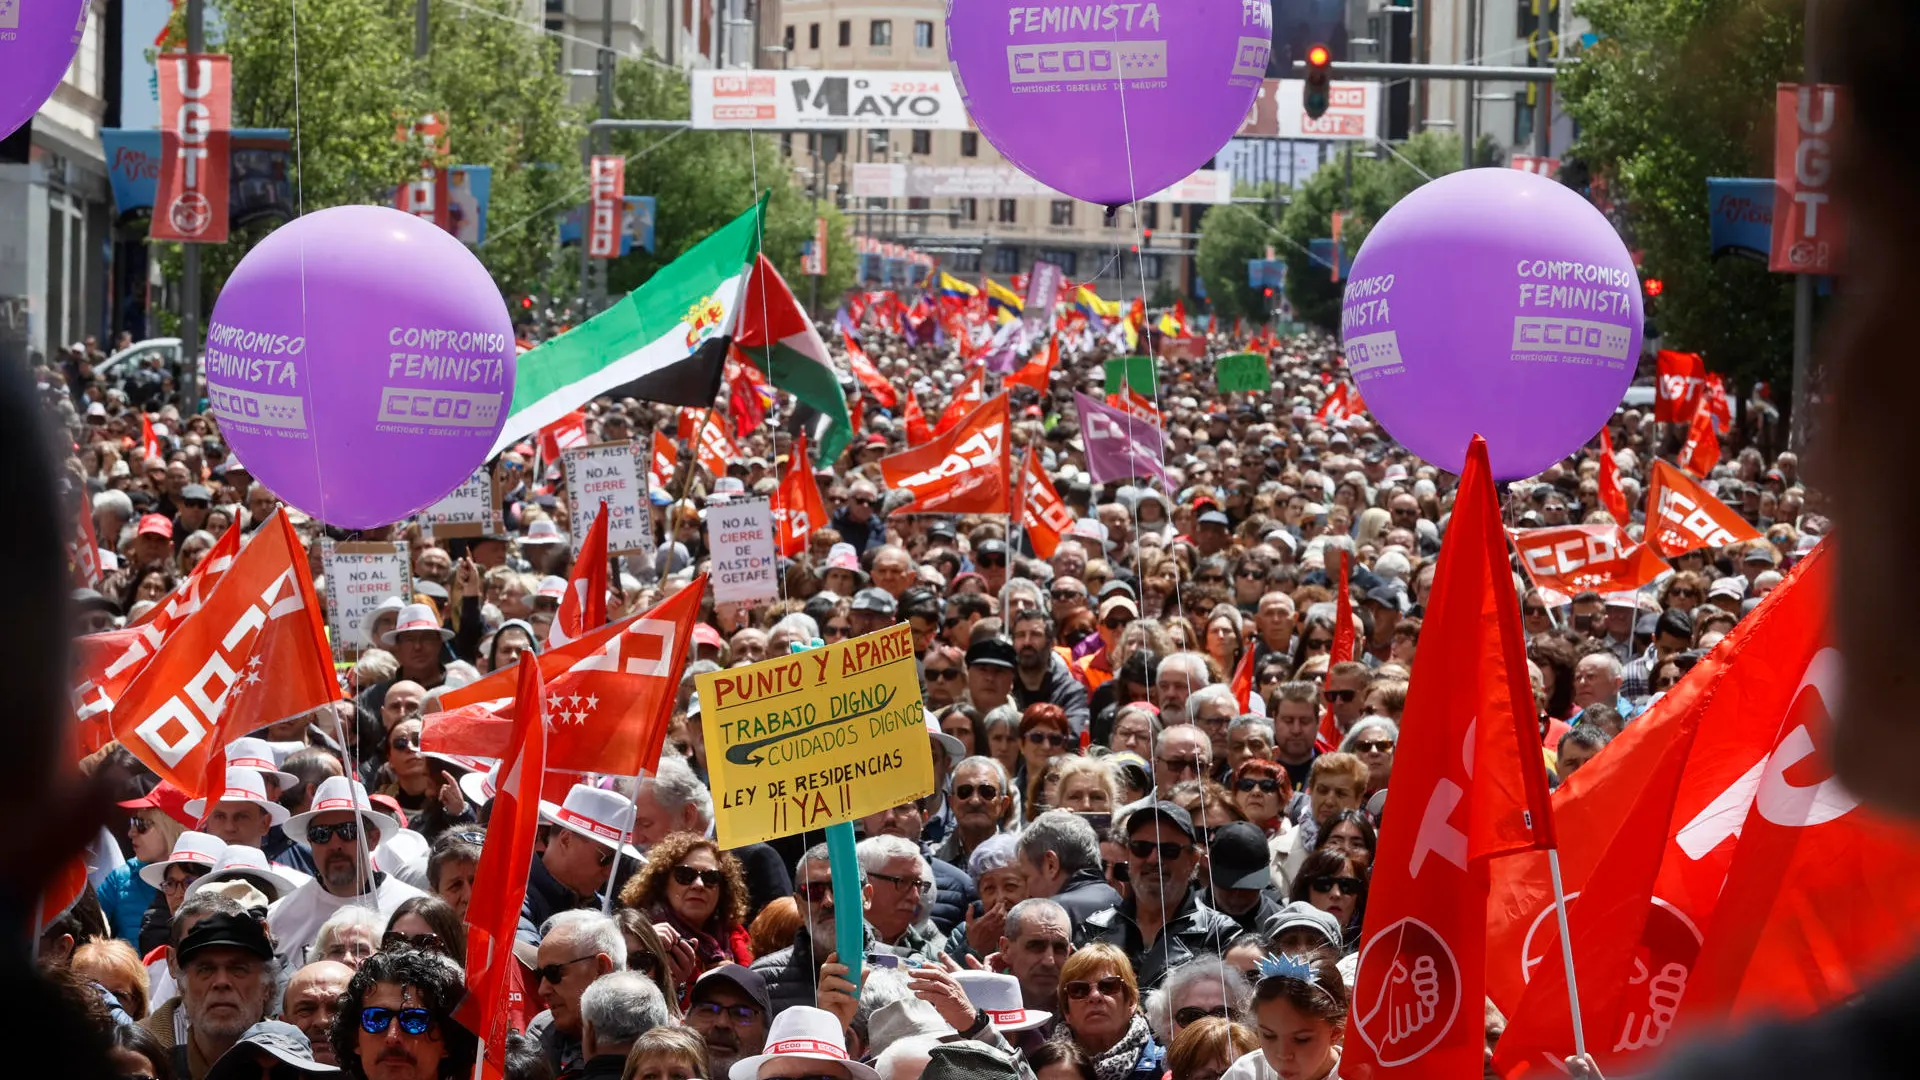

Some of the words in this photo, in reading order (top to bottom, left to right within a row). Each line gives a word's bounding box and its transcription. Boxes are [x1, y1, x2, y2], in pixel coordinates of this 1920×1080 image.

[1008, 4, 1160, 36] FEMINISTA
[1014, 51, 1111, 75] CCOO
[890, 82, 941, 93] 2024
[1011, 83, 1062, 93] COMISIONES
[175, 58, 212, 188] UGT
[1303, 115, 1344, 132] UGT
[1795, 84, 1836, 237] UGT
[591, 159, 615, 256] CCOO
[1517, 260, 1630, 288] COMPROMISO
[1519, 283, 1631, 319] FEMINISTA
[210, 321, 305, 355] COMPROMISO
[388, 327, 505, 353] COMPROMISO
[1520, 324, 1602, 348] CCOO
[208, 347, 298, 389] FEMINISTA
[389, 353, 503, 386] FEMINISTA
[1660, 373, 1706, 403] UGT
[211, 389, 260, 418] CCOO
[387, 395, 472, 420] CCOO
[586, 468, 603, 479] NO
[607, 466, 621, 476] AL
[584, 479, 627, 494] CIERRE
[583, 506, 635, 521] ALTOM
[722, 519, 741, 530] NO
[743, 517, 758, 527] AL
[720, 530, 764, 544] CIERRE
[336, 555, 383, 564] ALSTOM
[735, 545, 751, 556] DE
[350, 572, 367, 581] NO
[371, 571, 386, 580] AL
[718, 557, 771, 571] ALSTOM
[347, 582, 392, 594] CIERRE
[722, 569, 769, 584] GETAFE
[362, 596, 378, 606] DE
[714, 661, 803, 707] PUNTO
[813, 651, 830, 683] Y
[842, 628, 912, 676] APARTE
[720, 702, 816, 745] TRABAJO
[830, 683, 888, 719] DIGNO
[767, 725, 858, 766] CUIDADOS
[869, 700, 924, 738] DIGNOS
[723, 785, 757, 809] LEY
[768, 780, 786, 799] DE
[795, 748, 903, 793] RESIDENCIAS
